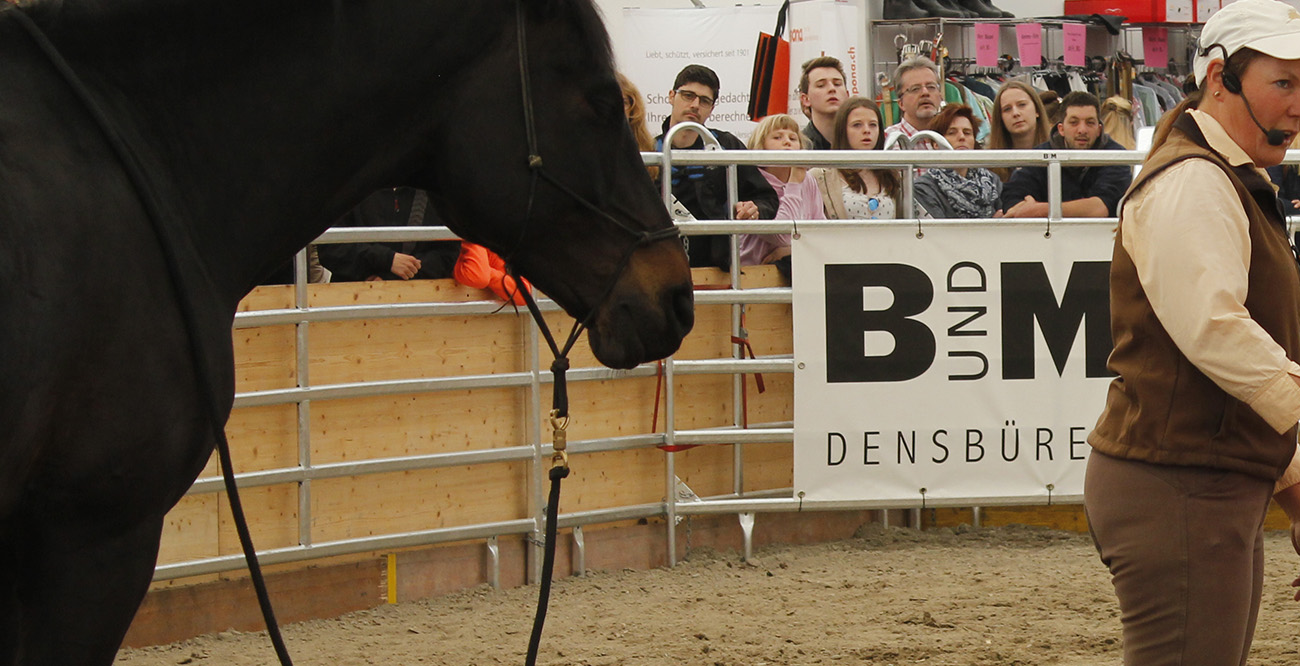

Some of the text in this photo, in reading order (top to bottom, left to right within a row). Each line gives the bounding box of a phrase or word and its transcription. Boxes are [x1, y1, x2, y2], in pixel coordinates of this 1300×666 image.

[645, 49, 750, 59] Liebt, schützt, versichert seit 1901
[847, 46, 859, 97] pona.ch
[647, 93, 670, 105] Scho
[709, 109, 751, 122] berechne
[946, 261, 989, 381] UND
[827, 419, 1086, 466] DENSBÜRE
